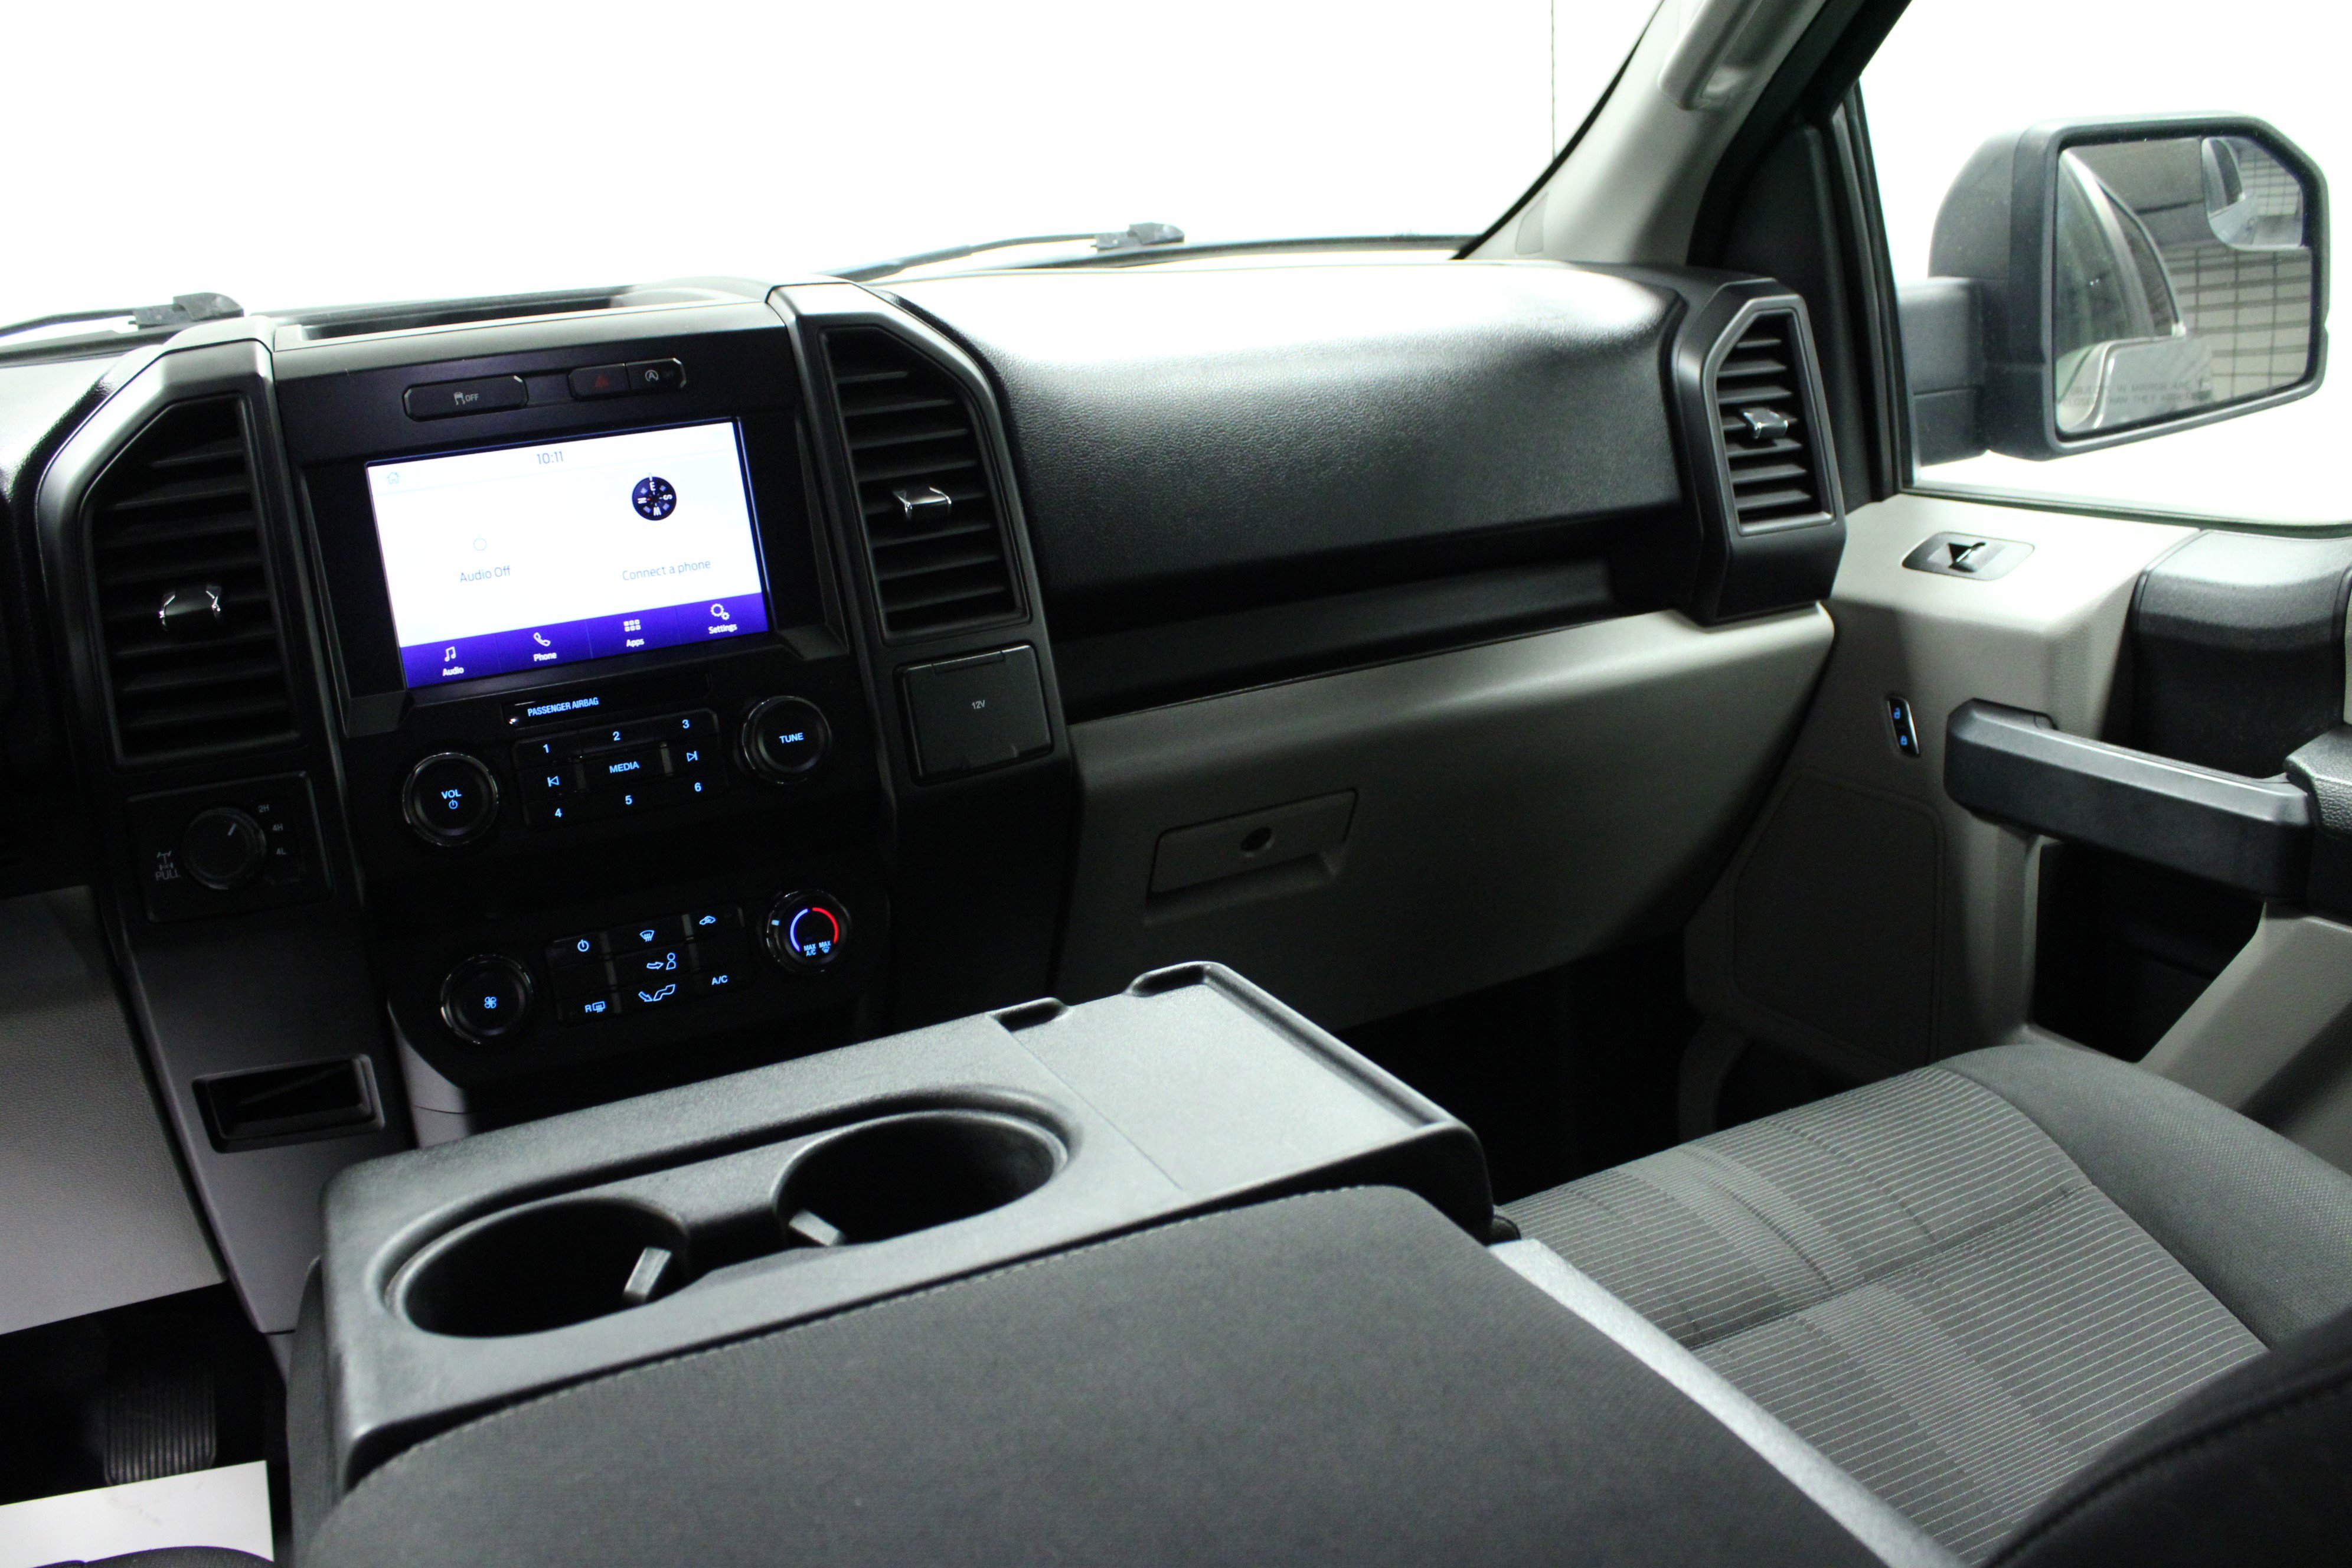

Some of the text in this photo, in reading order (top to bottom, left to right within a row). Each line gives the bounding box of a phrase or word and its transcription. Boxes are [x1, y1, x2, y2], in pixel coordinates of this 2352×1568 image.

[465, 393, 479, 402] OFF
[536, 450, 564, 465] 10:11
[460, 565, 511, 583] Audio Off
[622, 560, 711, 581] Connect a phone
[708, 623, 738, 635] Settings
[626, 637, 645, 648] Apps
[533, 652, 557, 662] Phone
[442, 666, 465, 677] Audio
[527, 697, 599, 717] PASSENGER AIRBAG
[972, 700, 985, 710] 12V
[682, 719, 690, 729] 3
[612, 731, 621, 741] 2
[779, 732, 804, 744] TUNE
[543, 744, 550, 753] 1
[609, 761, 639, 773] MEDIA
[694, 782, 702, 792] 6
[441, 789, 462, 799] VOL
[625, 795, 633, 805] 5
[258, 803, 270, 813] 2H
[554, 808, 562, 818] 4
[272, 823, 283, 832] 4H
[276, 847, 287, 855] 4L
[155, 868, 181, 881] PULL
[711, 975, 728, 985] A/C
[585, 1004, 592, 1013] R
